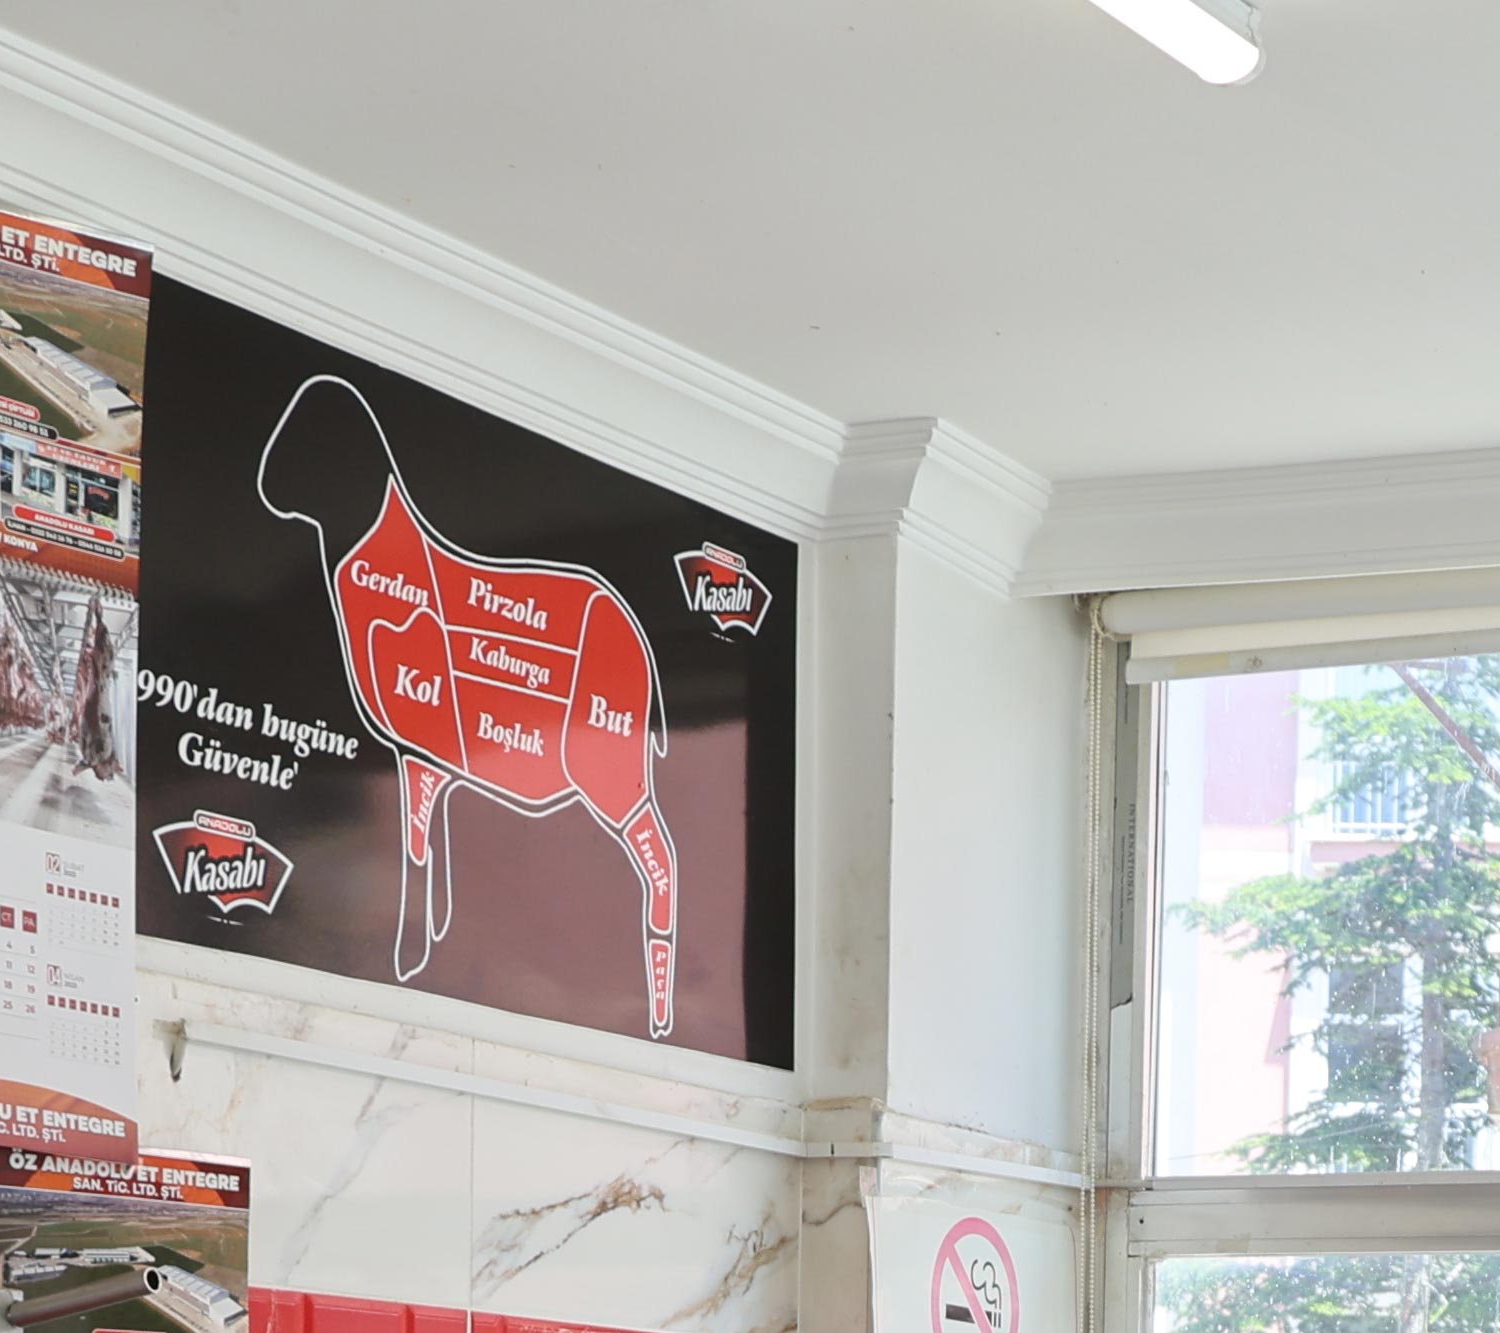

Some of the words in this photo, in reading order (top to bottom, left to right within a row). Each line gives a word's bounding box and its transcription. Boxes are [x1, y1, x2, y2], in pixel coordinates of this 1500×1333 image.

[1, 224, 30, 246] ET
[33, 232, 137, 277] ENTEGRE
[705, 545, 743, 568] ANADOLU
[350, 559, 429, 607] Gerdan
[467, 577, 548, 631] Pirzola
[692, 577, 753, 615] Kasabı
[395, 665, 442, 707] Kol
[469, 637, 551, 689] Kaburga
[138, 668, 254, 733] 990'dan
[261, 707, 359, 762] bugüne
[477, 713, 545, 758] Boşluk
[587, 693, 634, 739] But
[411, 770, 436, 832] İncik
[198, 813, 254, 837] ANADOLU
[183, 846, 266, 893] Kasabı
[635, 829, 668, 897] İncik
[16, 1099, 39, 1124] ET
[42, 1107, 126, 1138] ENTEGRE
[9, 1148, 38, 1170] ÖZ
[41, 1155, 136, 1180] ANADOLU
[137, 1164, 160, 1182] ET
[162, 1166, 240, 1192] ENTEGRE
